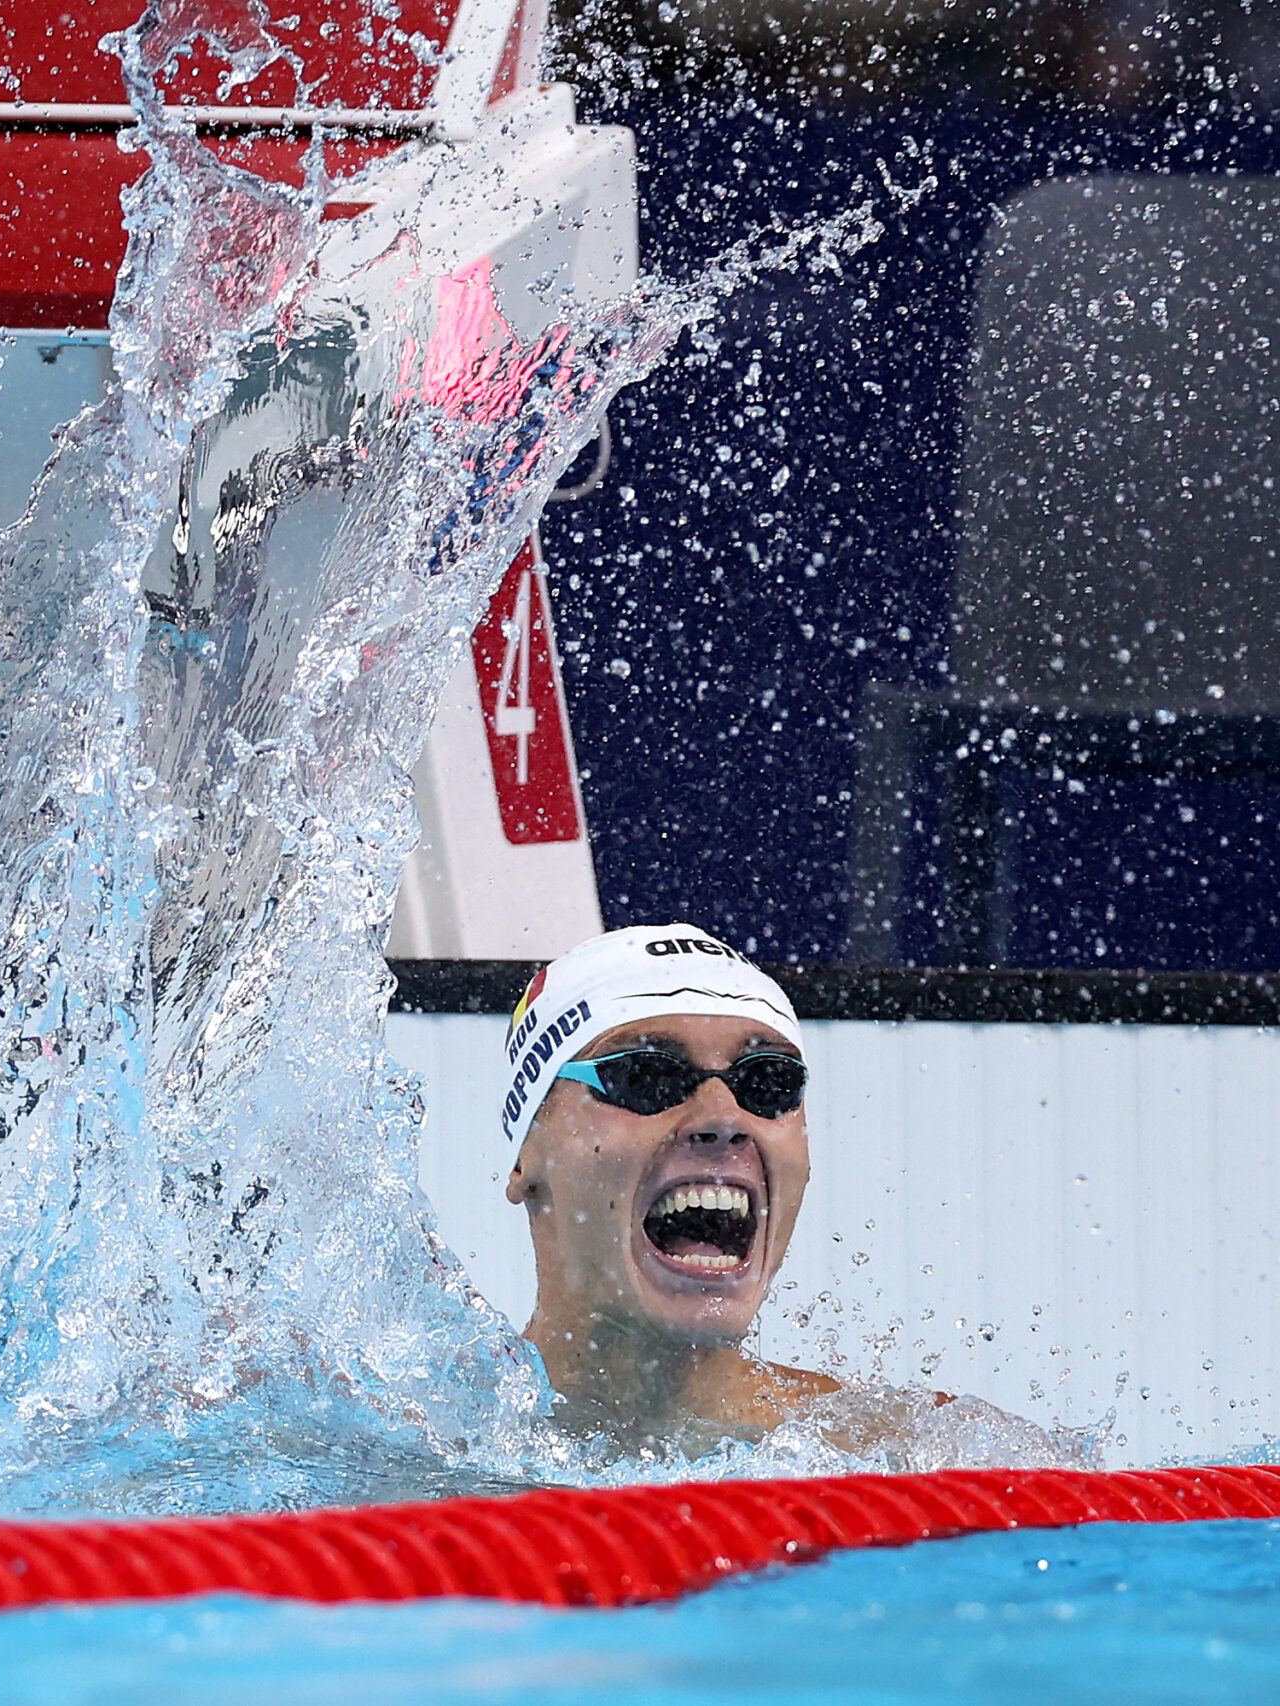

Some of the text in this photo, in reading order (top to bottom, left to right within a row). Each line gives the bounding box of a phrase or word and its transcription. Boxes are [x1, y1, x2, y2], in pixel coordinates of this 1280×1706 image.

[495, 569, 536, 785] 4
[645, 938, 761, 971] aren
[502, 999, 592, 1143] POPOVICI
[508, 1008, 538, 1067] ROU
